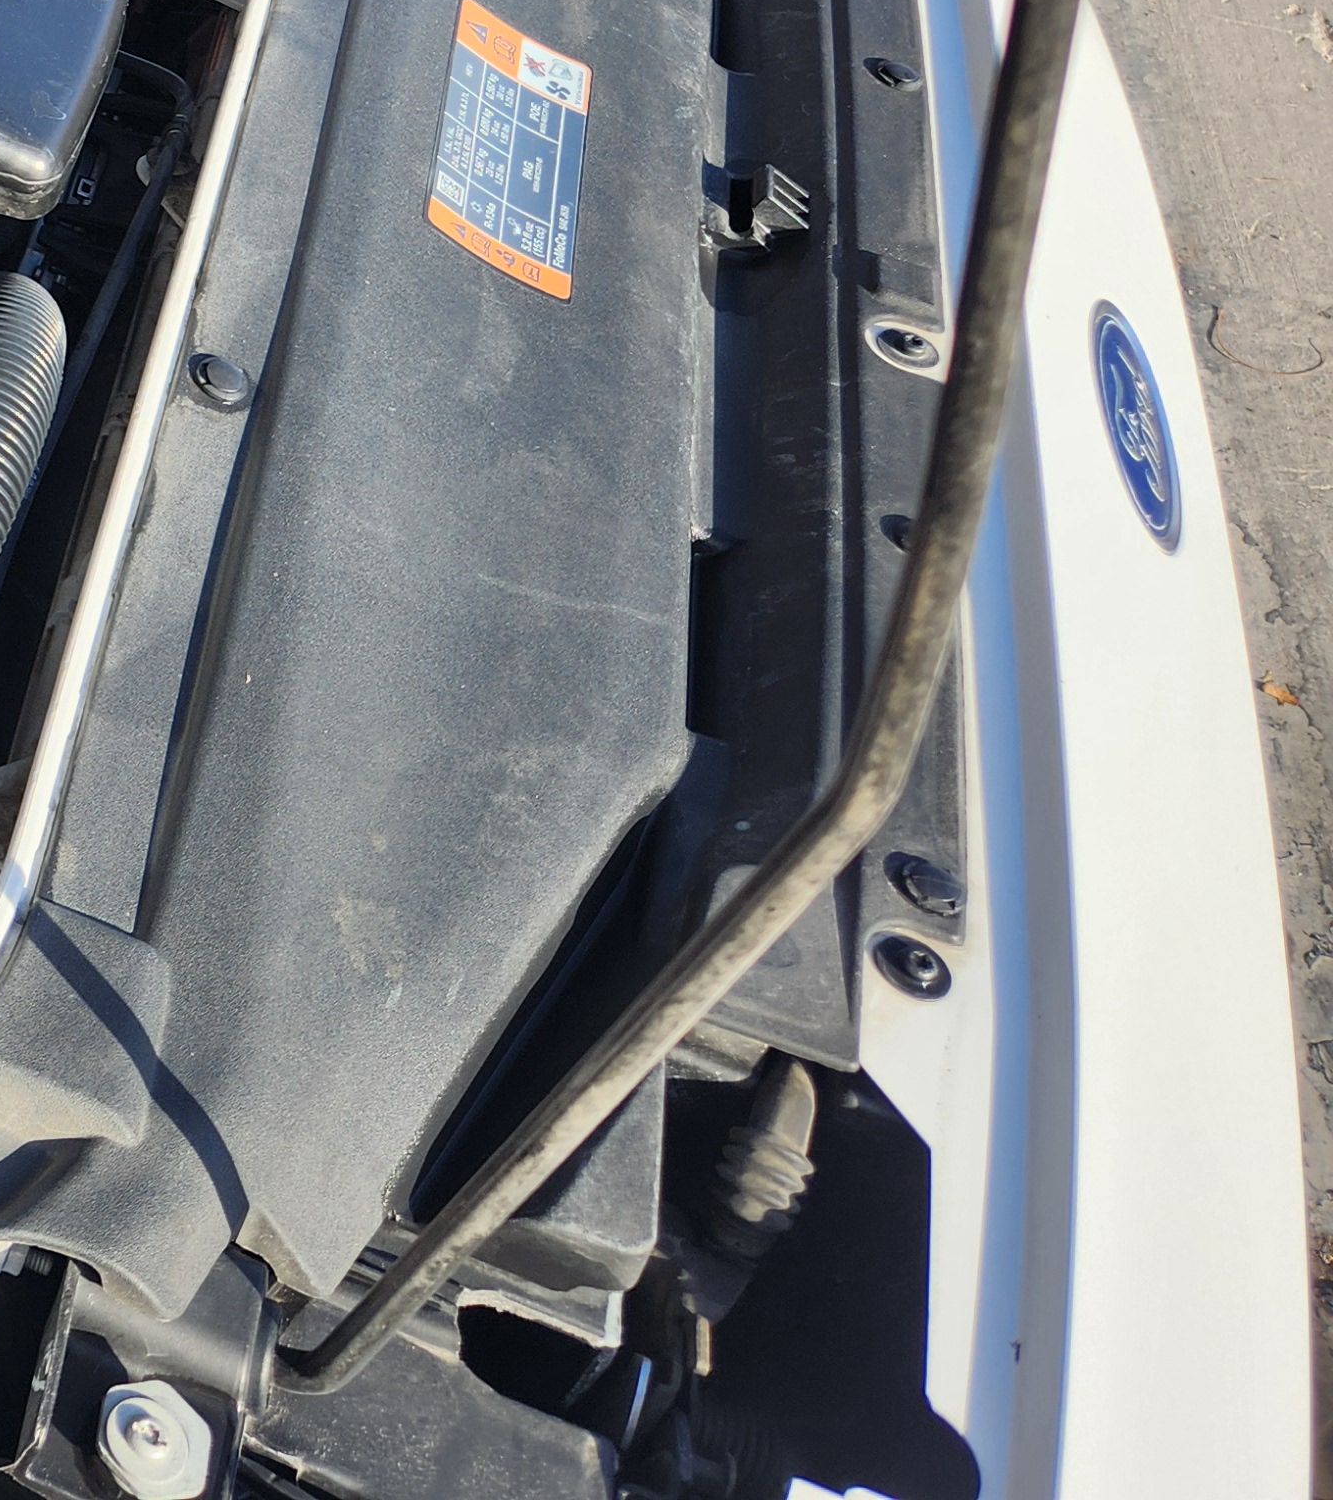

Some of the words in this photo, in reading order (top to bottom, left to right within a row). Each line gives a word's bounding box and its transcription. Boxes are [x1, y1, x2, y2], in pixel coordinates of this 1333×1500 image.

[486, 70, 498, 84] kg
[481, 106, 493, 120] kg
[529, 100, 540, 123] POE
[476, 145, 488, 160] kg
[521, 158, 533, 181] PAG
[484, 199, 496, 231] R-134a
[558, 215, 568, 233] SAE
[522, 229, 532, 240] fl
[525, 219, 534, 234] oz
[534, 223, 547, 242] cc)
[521, 236, 531, 253] 5.2
[532, 236, 546, 260] (155
[552, 229, 566, 271] FoMoCo
[1110, 344, 1167, 502] Ford
